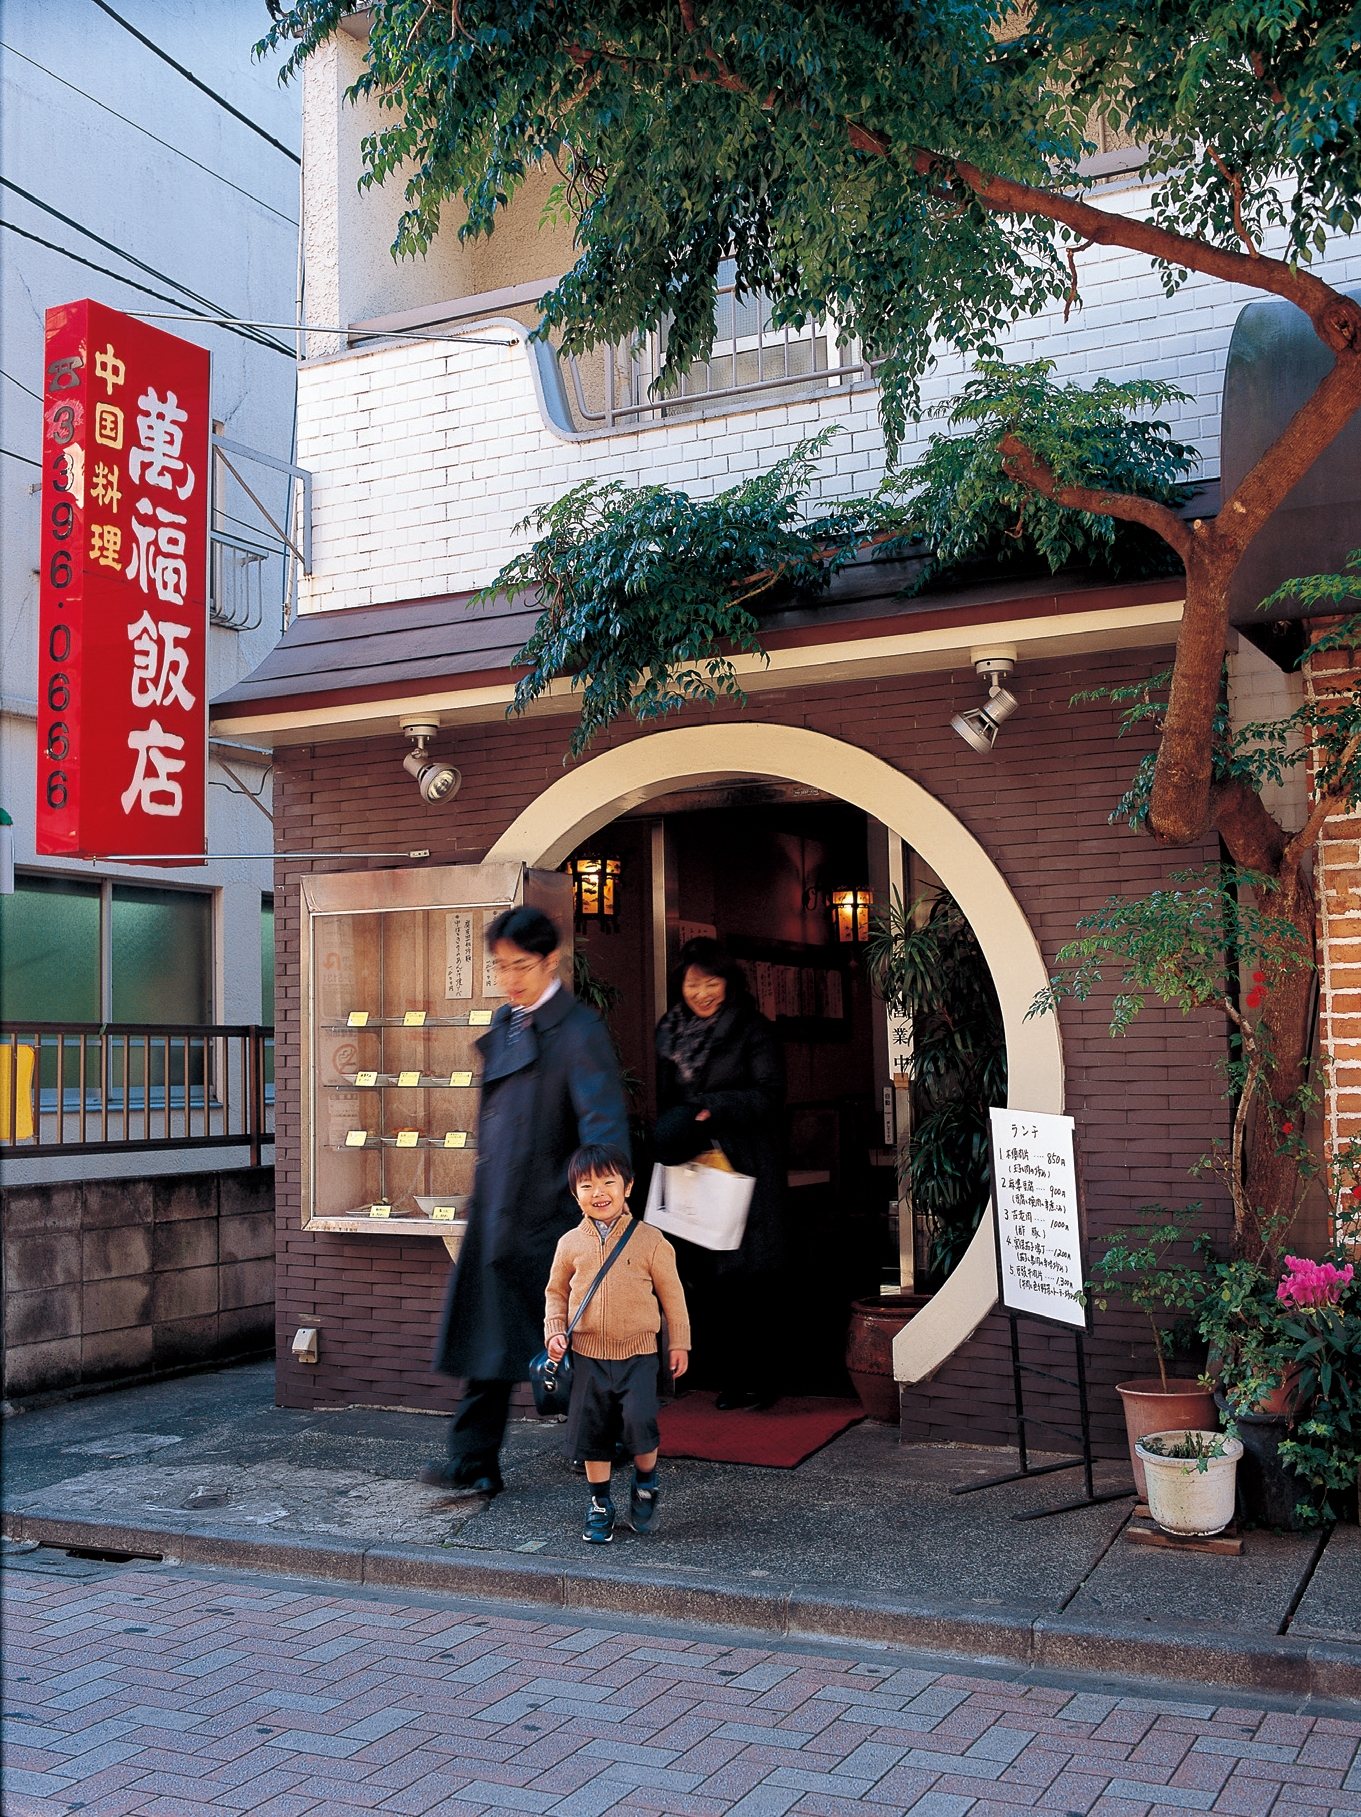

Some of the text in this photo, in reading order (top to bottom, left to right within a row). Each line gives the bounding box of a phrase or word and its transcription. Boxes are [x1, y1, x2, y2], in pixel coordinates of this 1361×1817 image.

[89, 343, 126, 572] 中国料理
[121, 386, 196, 817] 萬福飯店
[1011, 1124, 1039, 1138] ランチ
[1046, 1152, 1066, 1166] 850円
[1049, 1185, 1066, 1198] 900円
